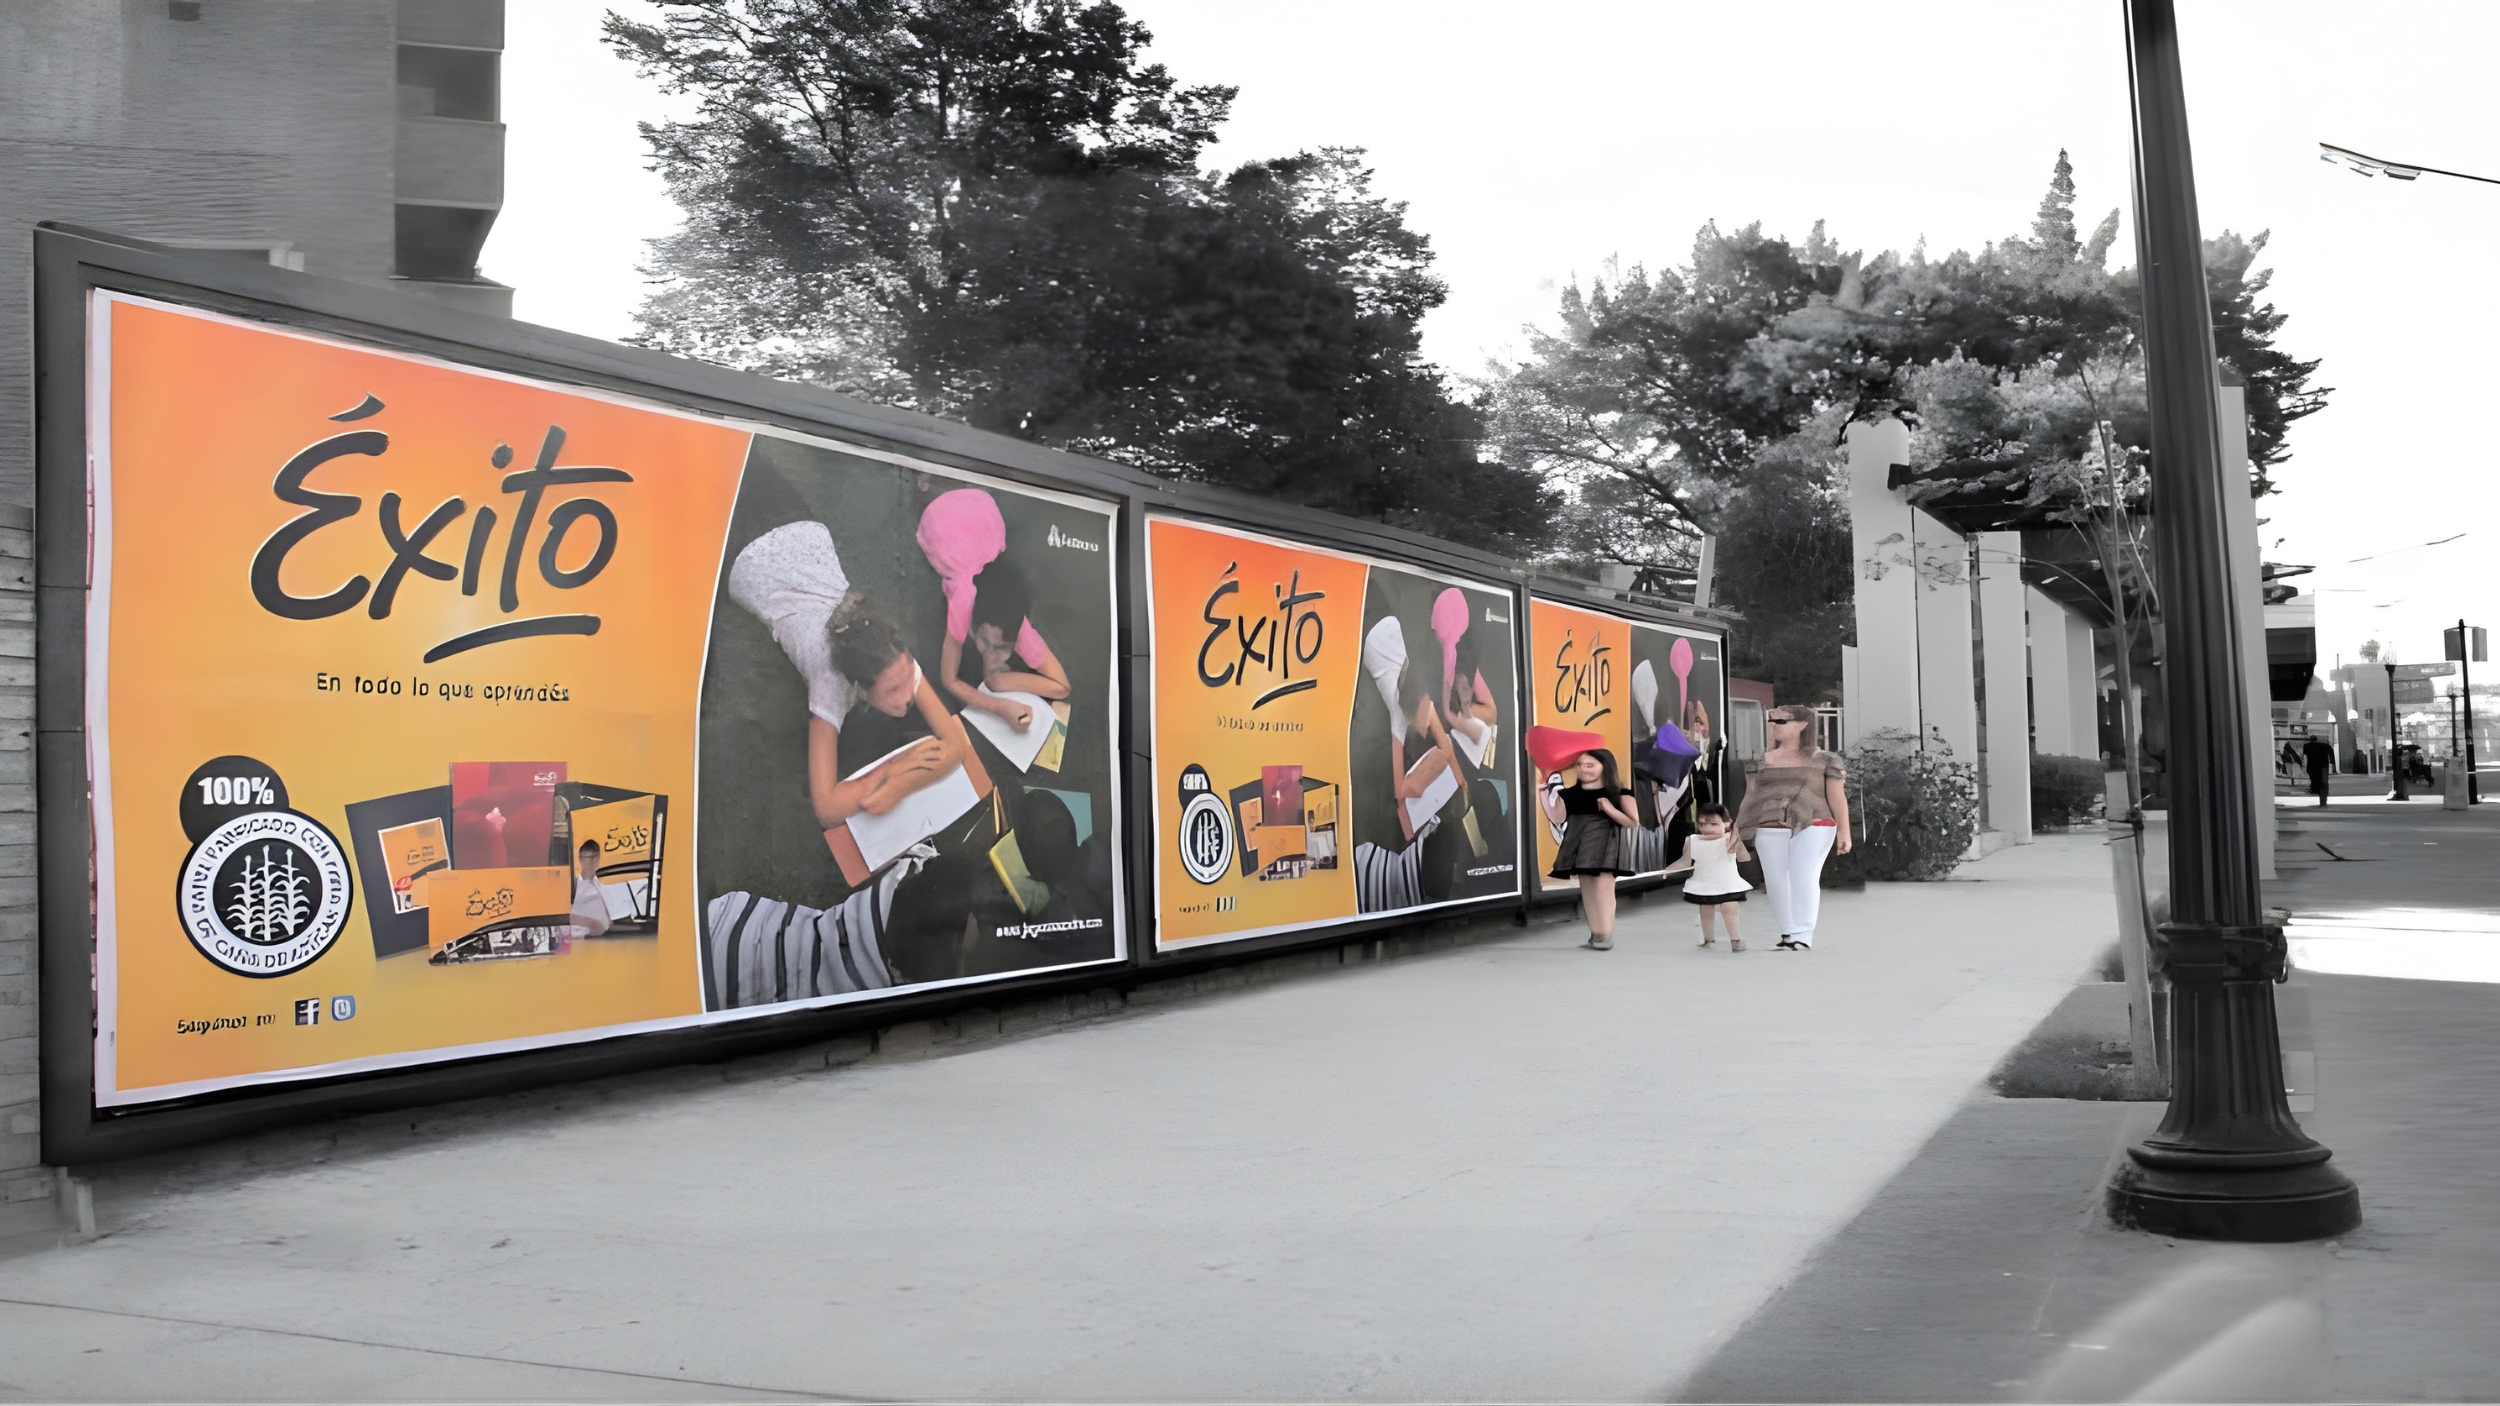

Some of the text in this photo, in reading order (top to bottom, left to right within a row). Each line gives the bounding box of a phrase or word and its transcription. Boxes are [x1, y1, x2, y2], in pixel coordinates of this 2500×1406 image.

[250, 391, 634, 622] Éxito
[1197, 561, 1326, 688] Éxito
[316, 672, 341, 692] En
[412, 677, 429, 696] lo
[439, 683, 473, 701] que
[198, 776, 275, 805] 100%
